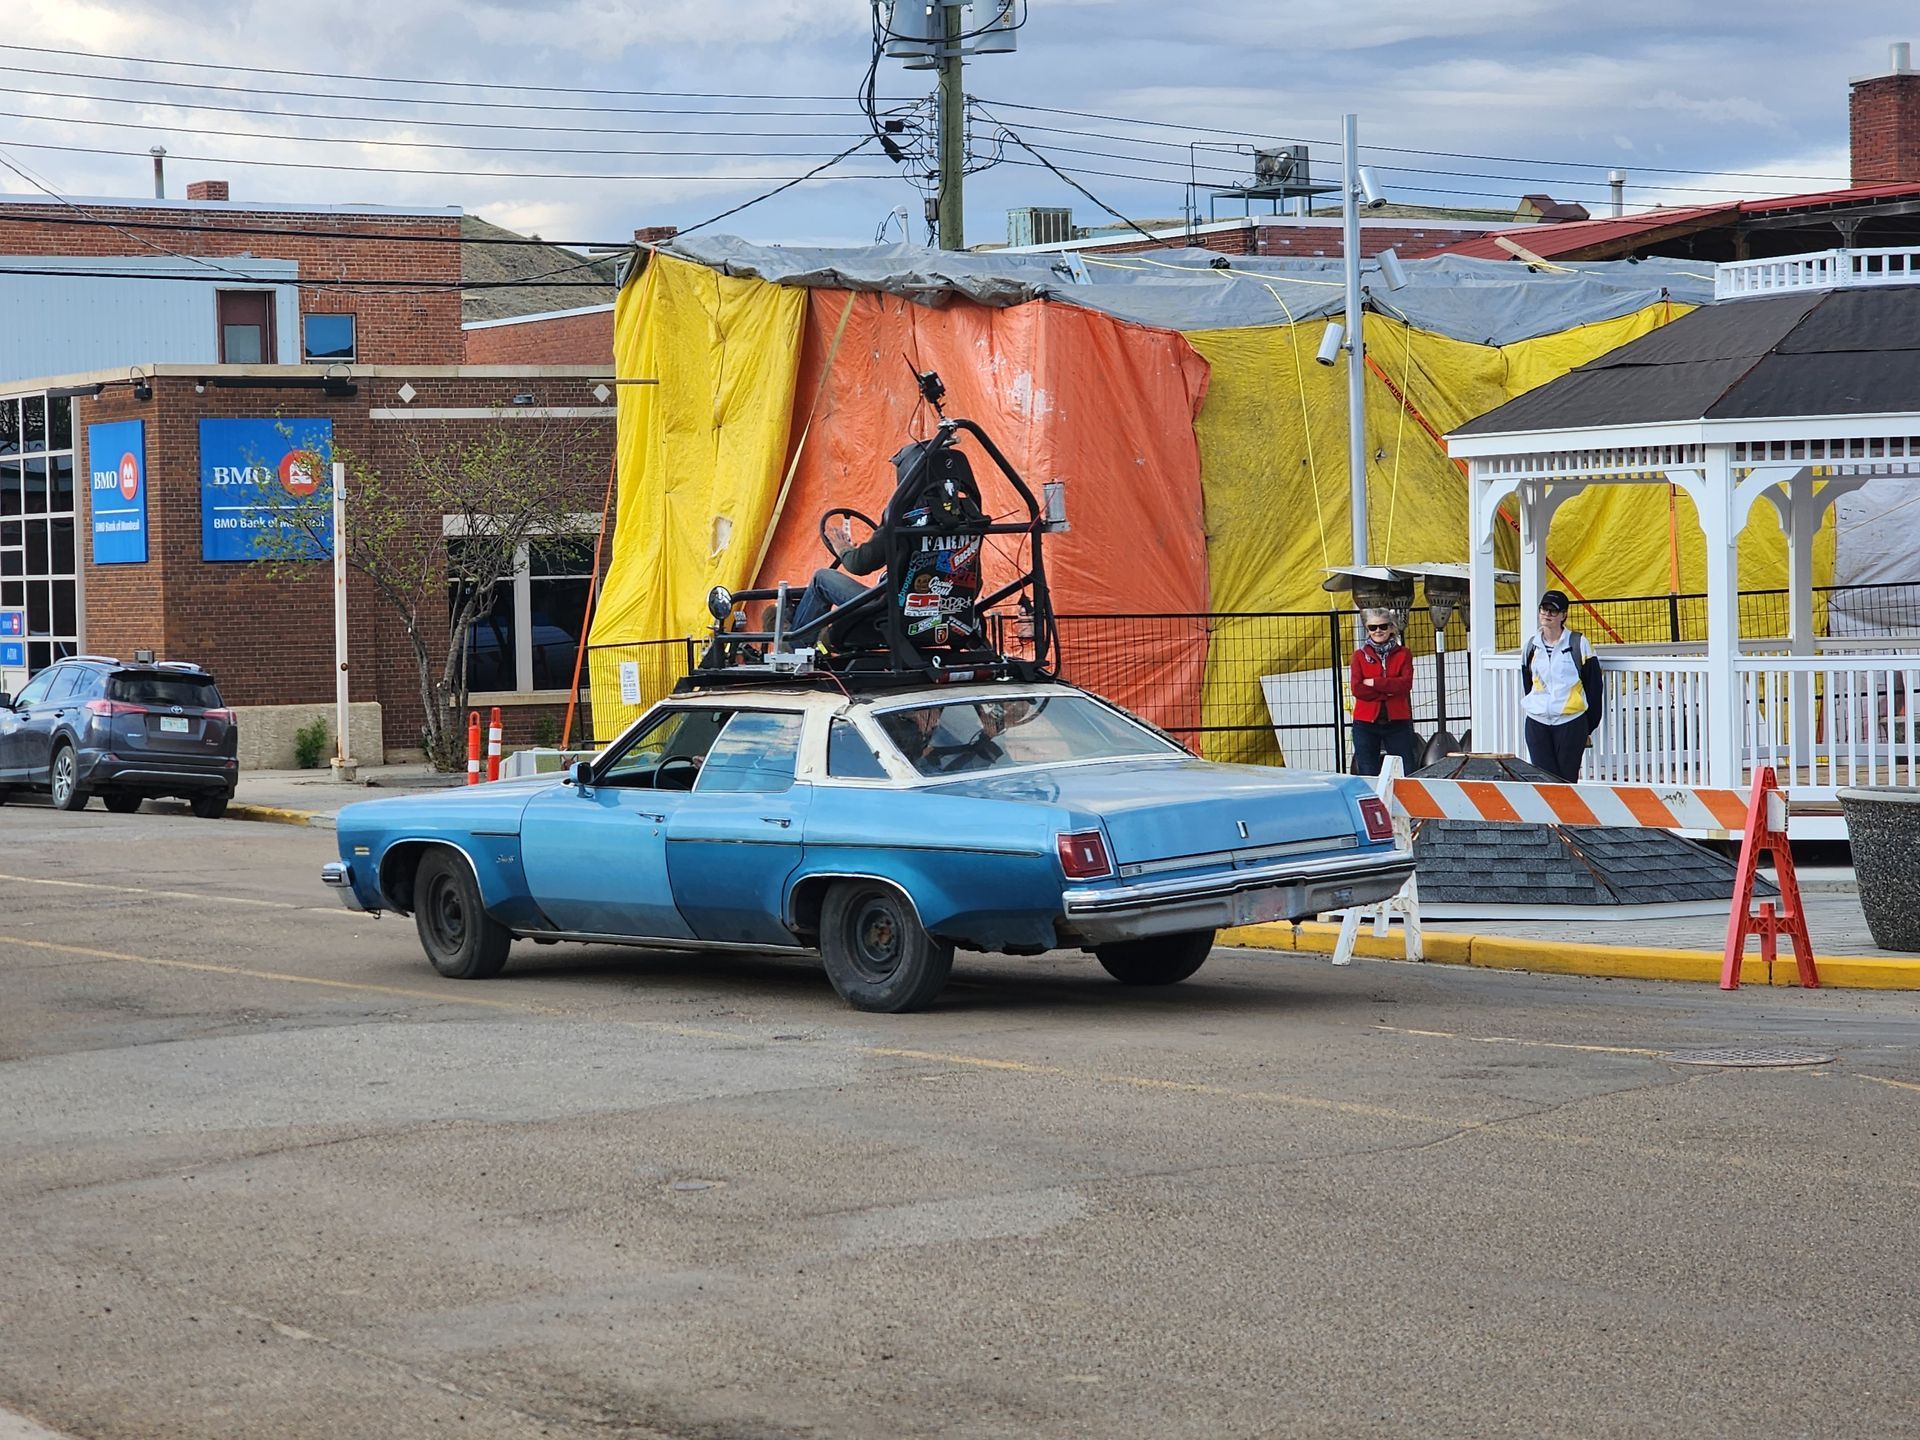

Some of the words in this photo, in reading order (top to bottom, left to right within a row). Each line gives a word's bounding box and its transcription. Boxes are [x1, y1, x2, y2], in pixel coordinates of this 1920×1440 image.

[94, 471, 117, 490] BMO
[213, 466, 271, 485] BMO
[213, 518, 238, 529] BMO
[240, 516, 266, 529] Bank
